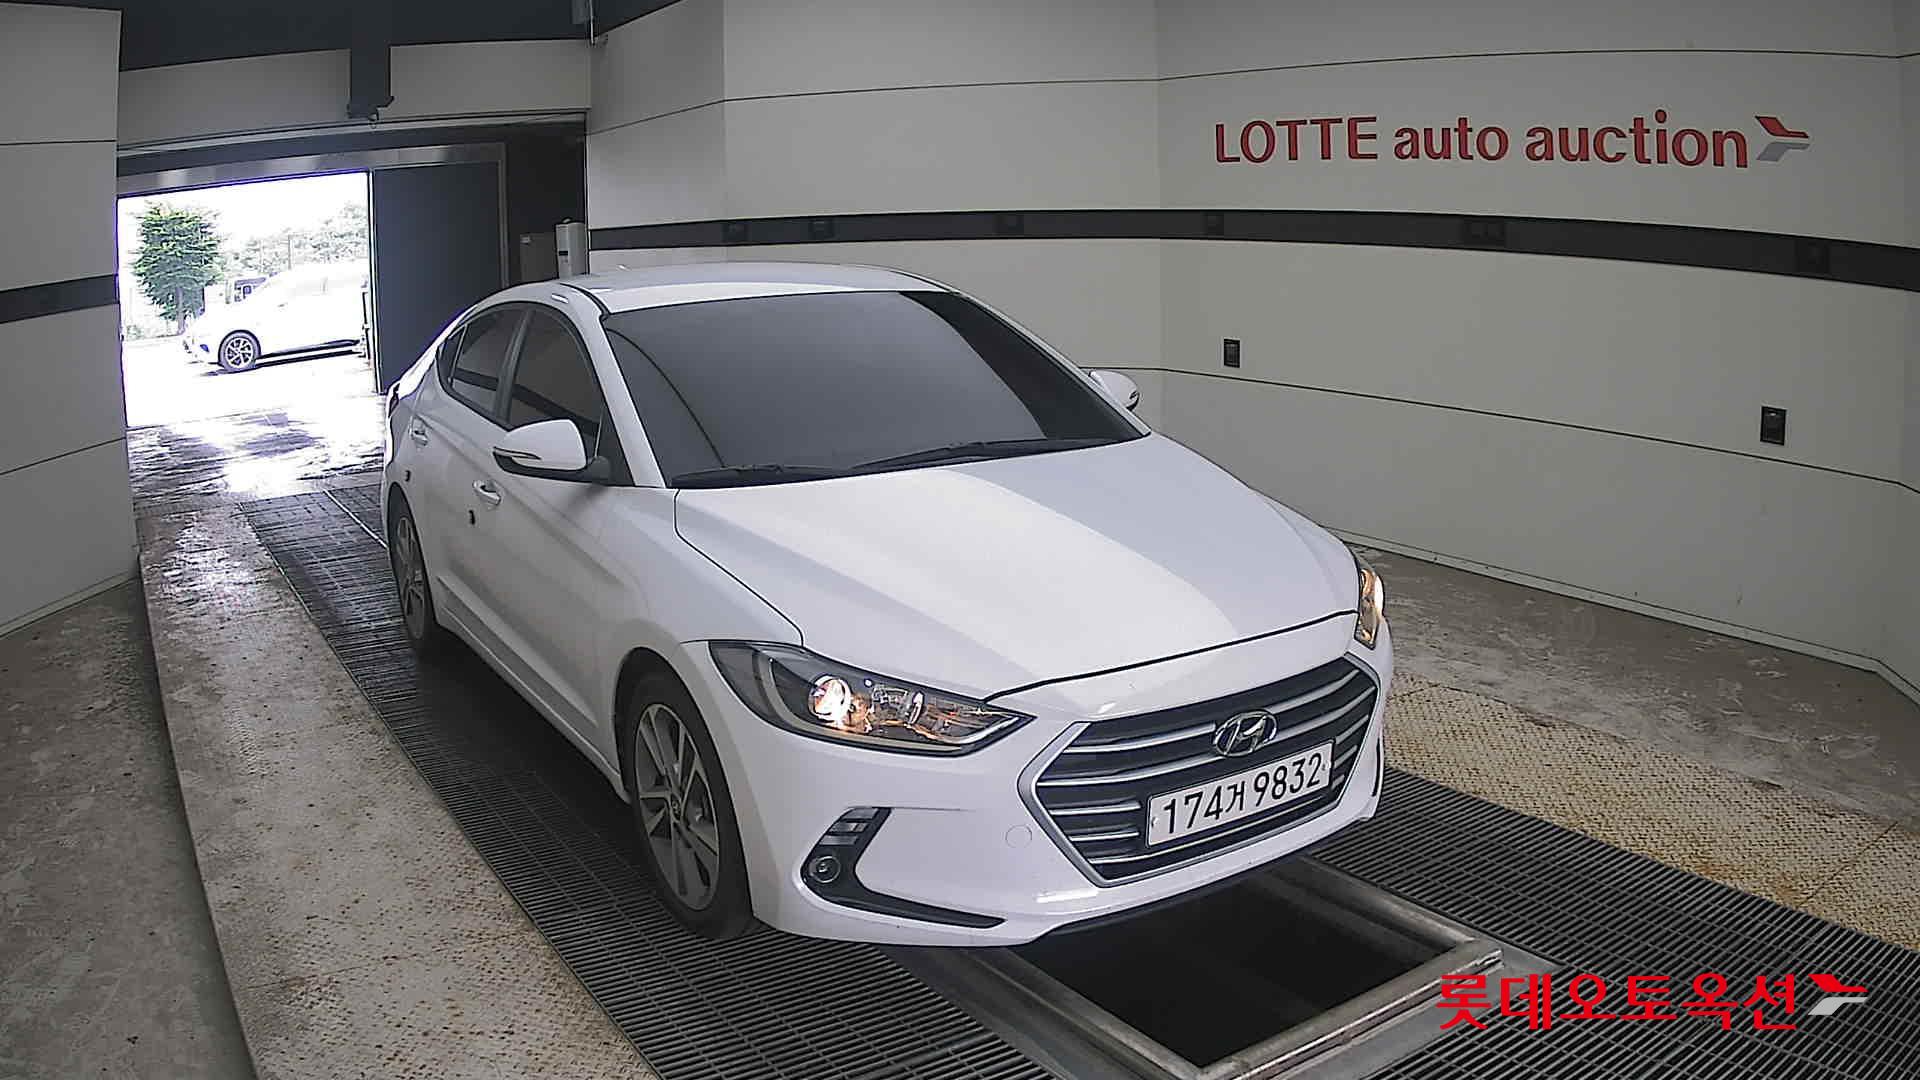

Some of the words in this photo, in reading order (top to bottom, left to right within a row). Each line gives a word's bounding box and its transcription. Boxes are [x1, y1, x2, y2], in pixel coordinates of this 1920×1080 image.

[1215, 116, 1378, 163] LOTTE
[1394, 117, 1509, 160] auto
[1525, 110, 1748, 168] auction
[1163, 780, 1246, 834] 174거
[1253, 752, 1322, 807] 9832
